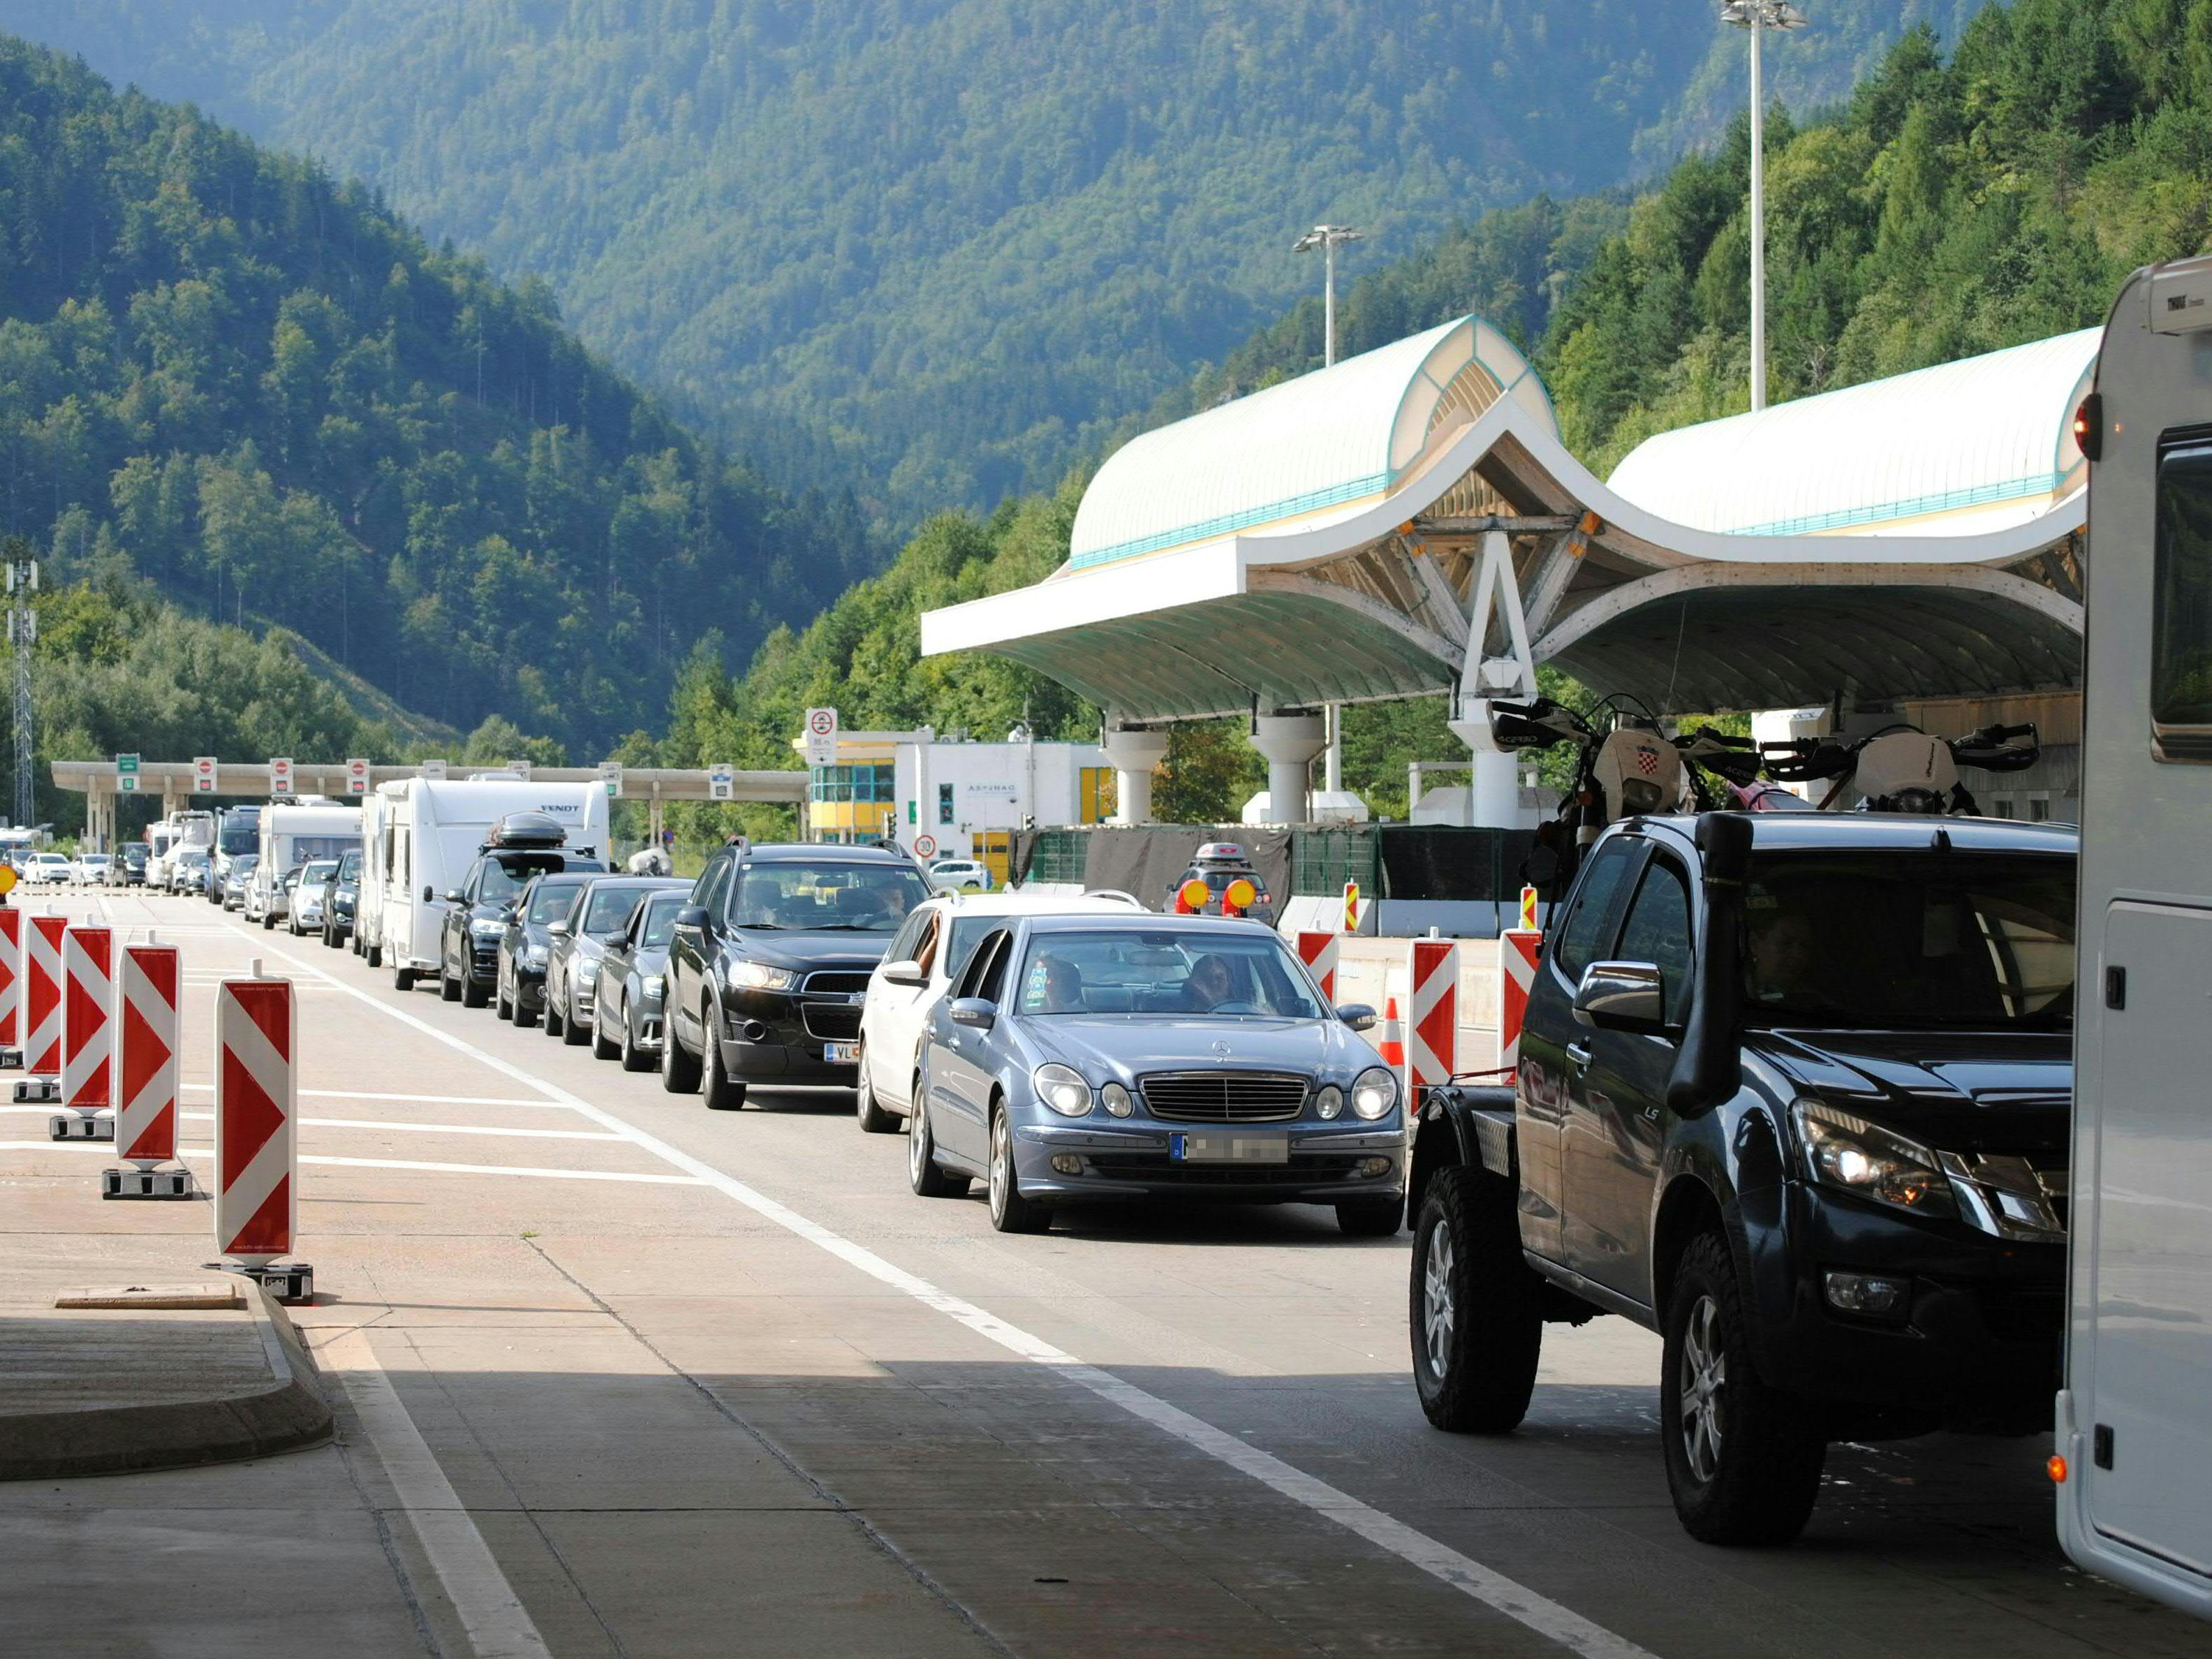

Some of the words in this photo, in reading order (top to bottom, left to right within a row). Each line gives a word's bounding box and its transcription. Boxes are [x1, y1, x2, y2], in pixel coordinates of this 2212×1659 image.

[920, 841, 931, 851] 30
[837, 1047, 851, 1059] VL
[1644, 1106, 1659, 1120] LS
